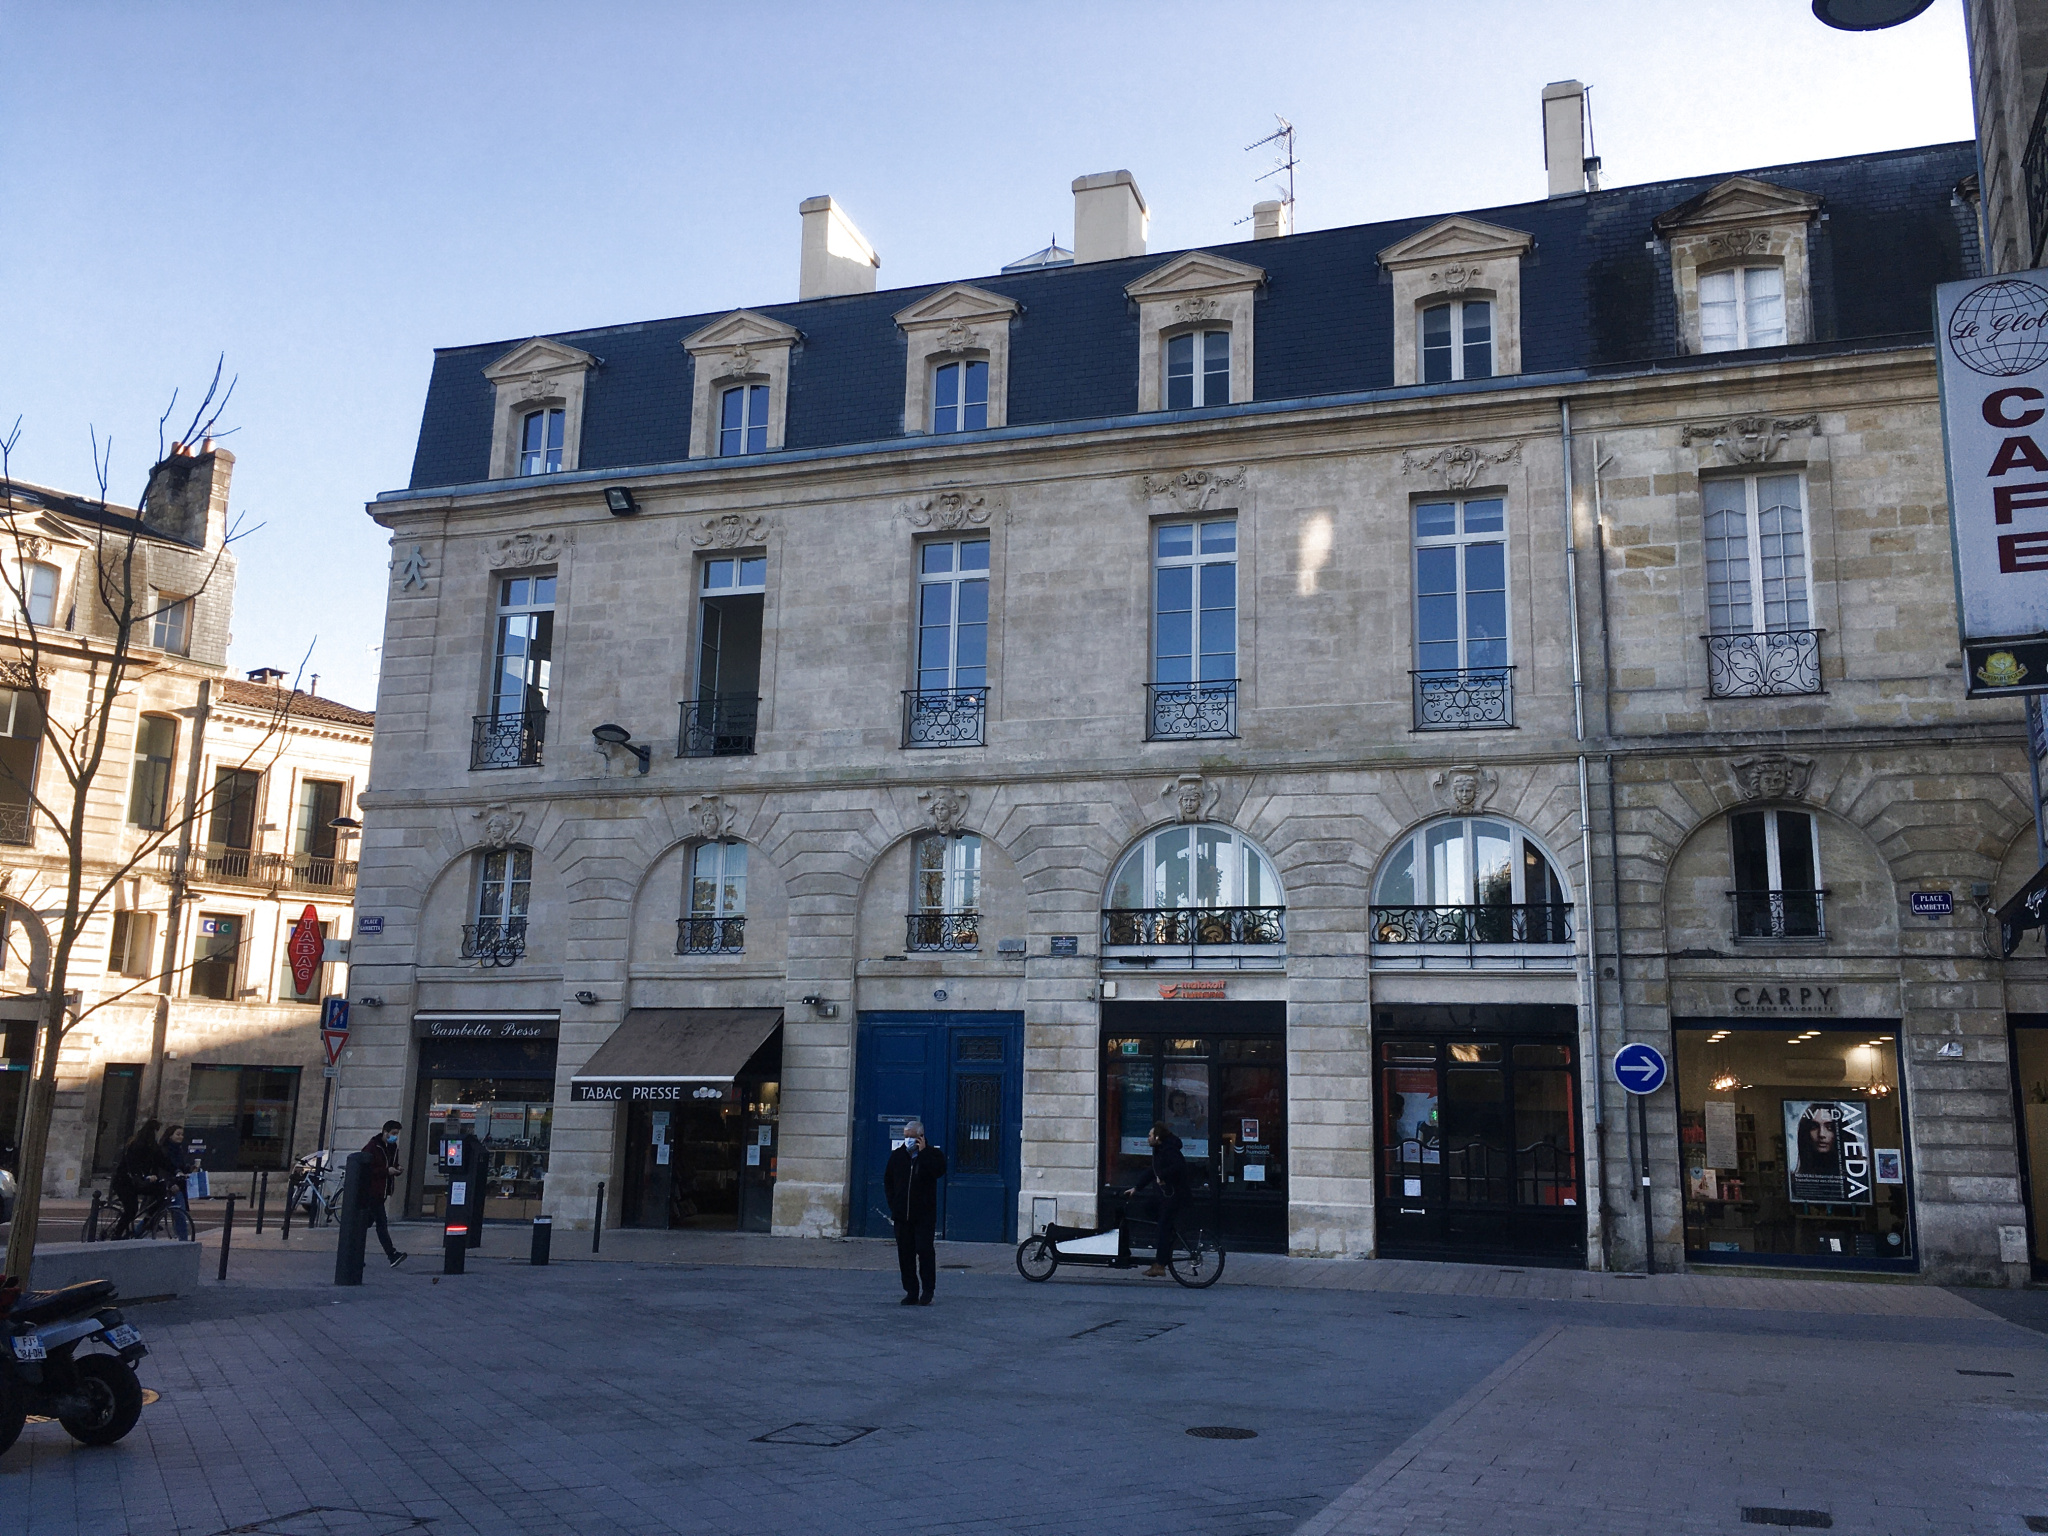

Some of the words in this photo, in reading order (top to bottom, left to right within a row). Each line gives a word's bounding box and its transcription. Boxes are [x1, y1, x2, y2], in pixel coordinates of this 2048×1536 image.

[1951, 319, 1980, 340] Le
[1982, 387, 2048, 575] CAFE
[1981, 669, 2025, 682] GRIMBERGEN
[1914, 903, 1950, 911] GAMBETTA
[206, 922, 229, 932] CIC
[296, 918, 316, 980] TABAC
[1181, 980, 1226, 989] malakoff
[1181, 990, 1225, 999] humanis
[1734, 987, 1832, 1006] CARPY
[430, 1022, 492, 1037] Gambetta
[500, 1022, 541, 1037] Presse
[580, 1086, 622, 1100] TABAC
[632, 1086, 680, 1100] PRESSE
[1840, 1101, 1869, 1199] AVEDA
